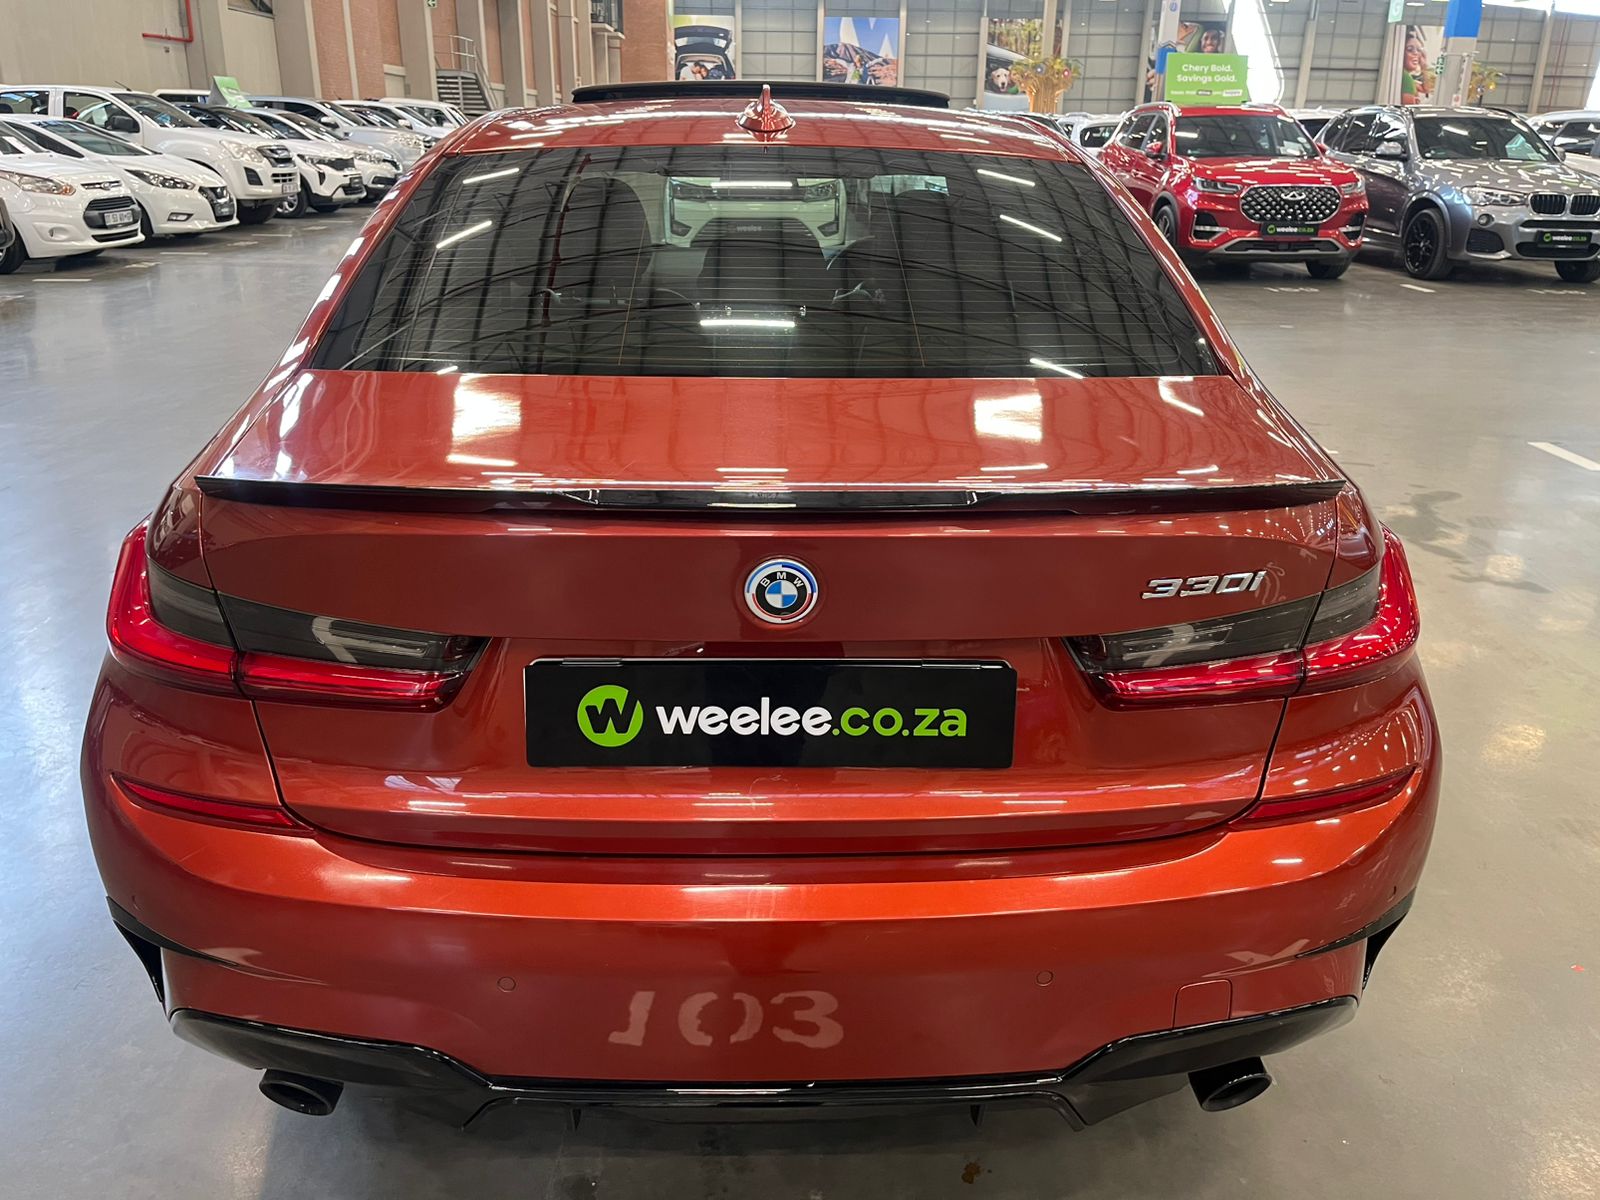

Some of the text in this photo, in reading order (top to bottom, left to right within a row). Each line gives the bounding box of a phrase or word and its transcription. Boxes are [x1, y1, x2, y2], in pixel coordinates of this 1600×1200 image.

[1182, 64, 1233, 74] Chery Bold.
[1176, 74, 1237, 84] Savings Gold.
[760, 571, 804, 588] BMW
[1141, 570, 1267, 600] 330i
[655, 696, 968, 738] weelee.co.za
